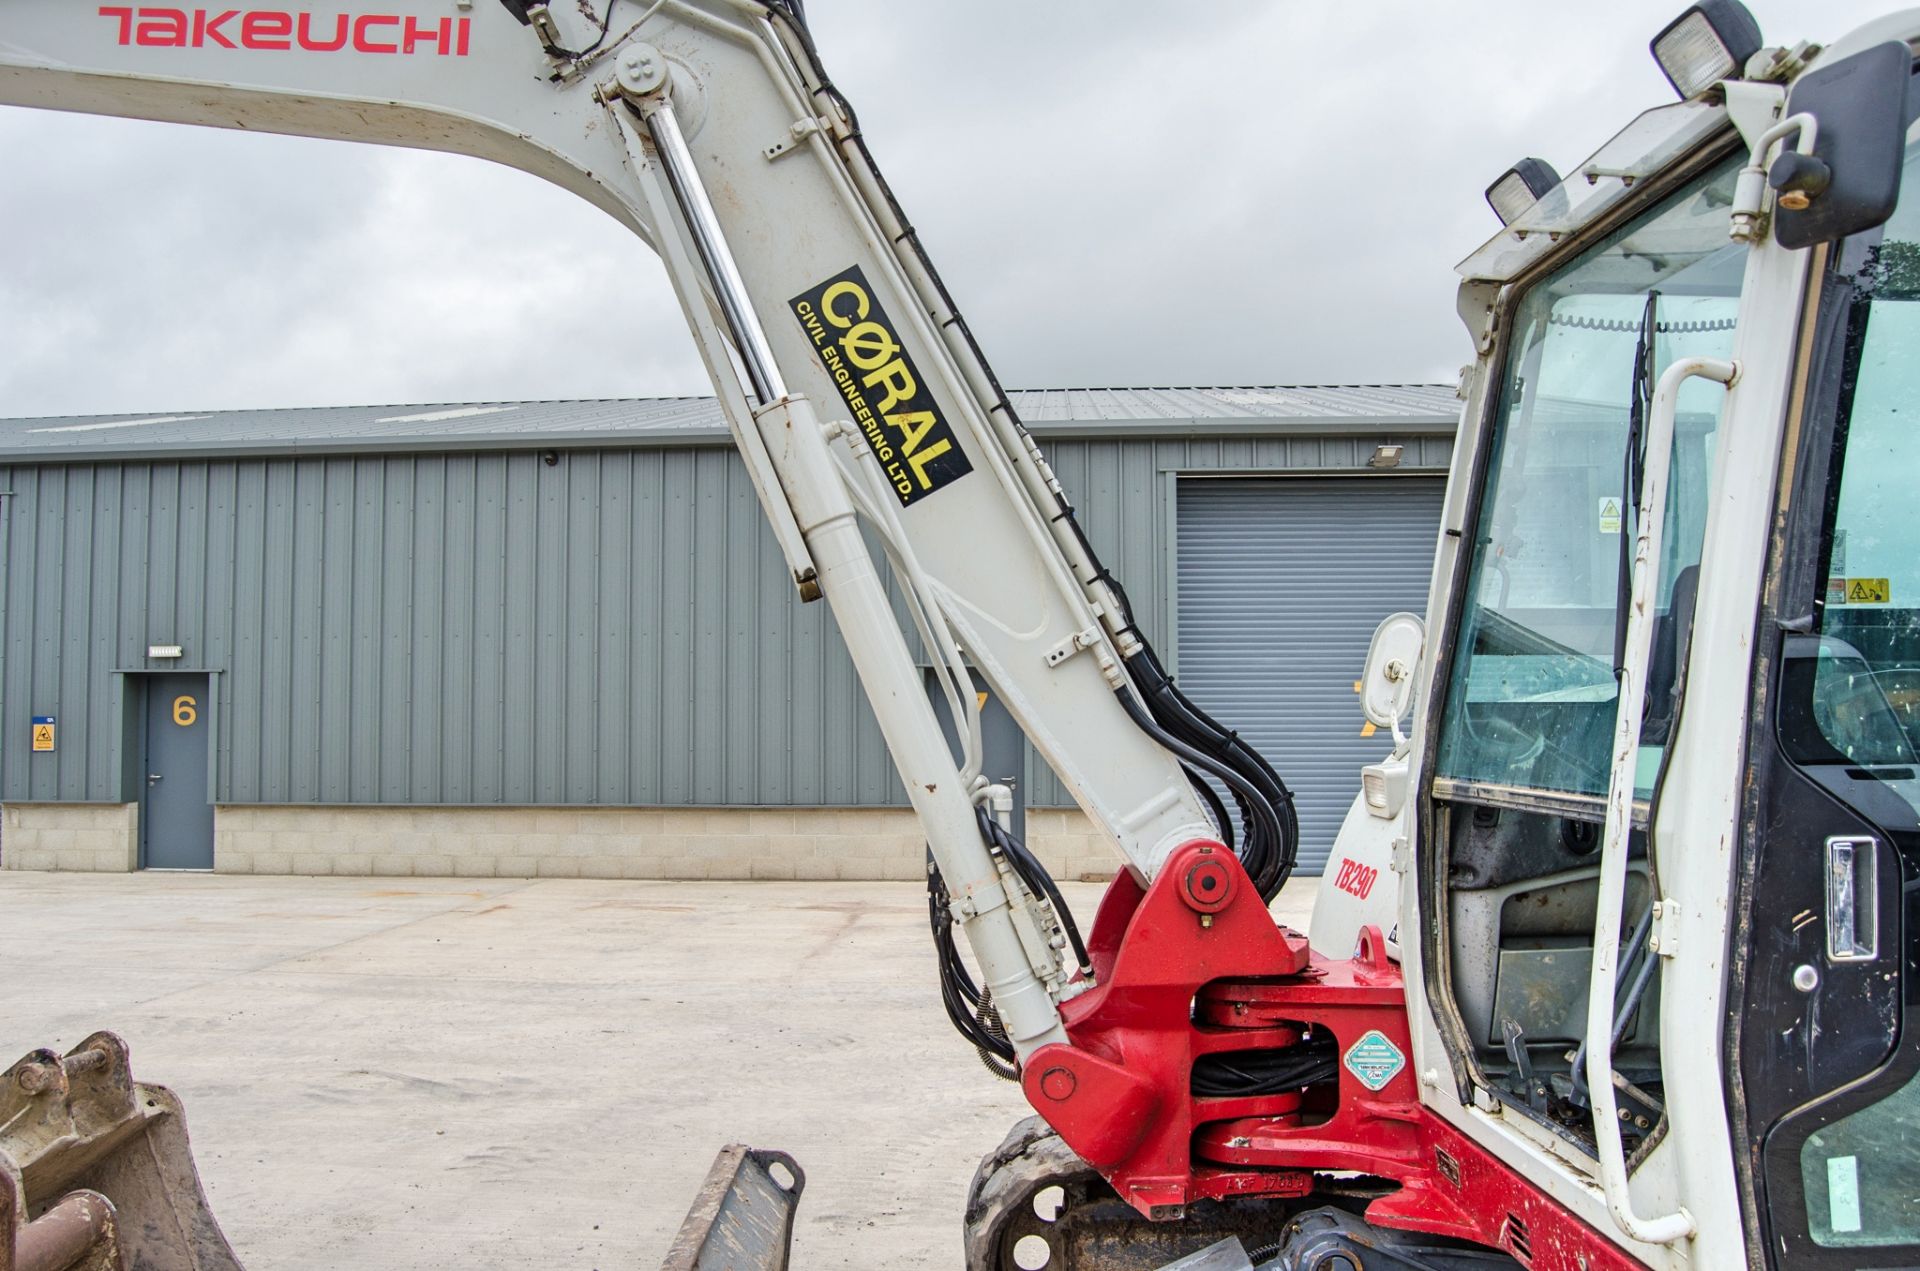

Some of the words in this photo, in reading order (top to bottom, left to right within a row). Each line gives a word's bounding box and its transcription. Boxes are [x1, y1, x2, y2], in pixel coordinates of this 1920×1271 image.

[797, 301, 827, 346] CIVIL
[822, 346, 894, 462] ENGINEERING
[887, 462, 914, 500] LTD.
[174, 696, 196, 726] 6
[1335, 857, 1378, 900] TB290
